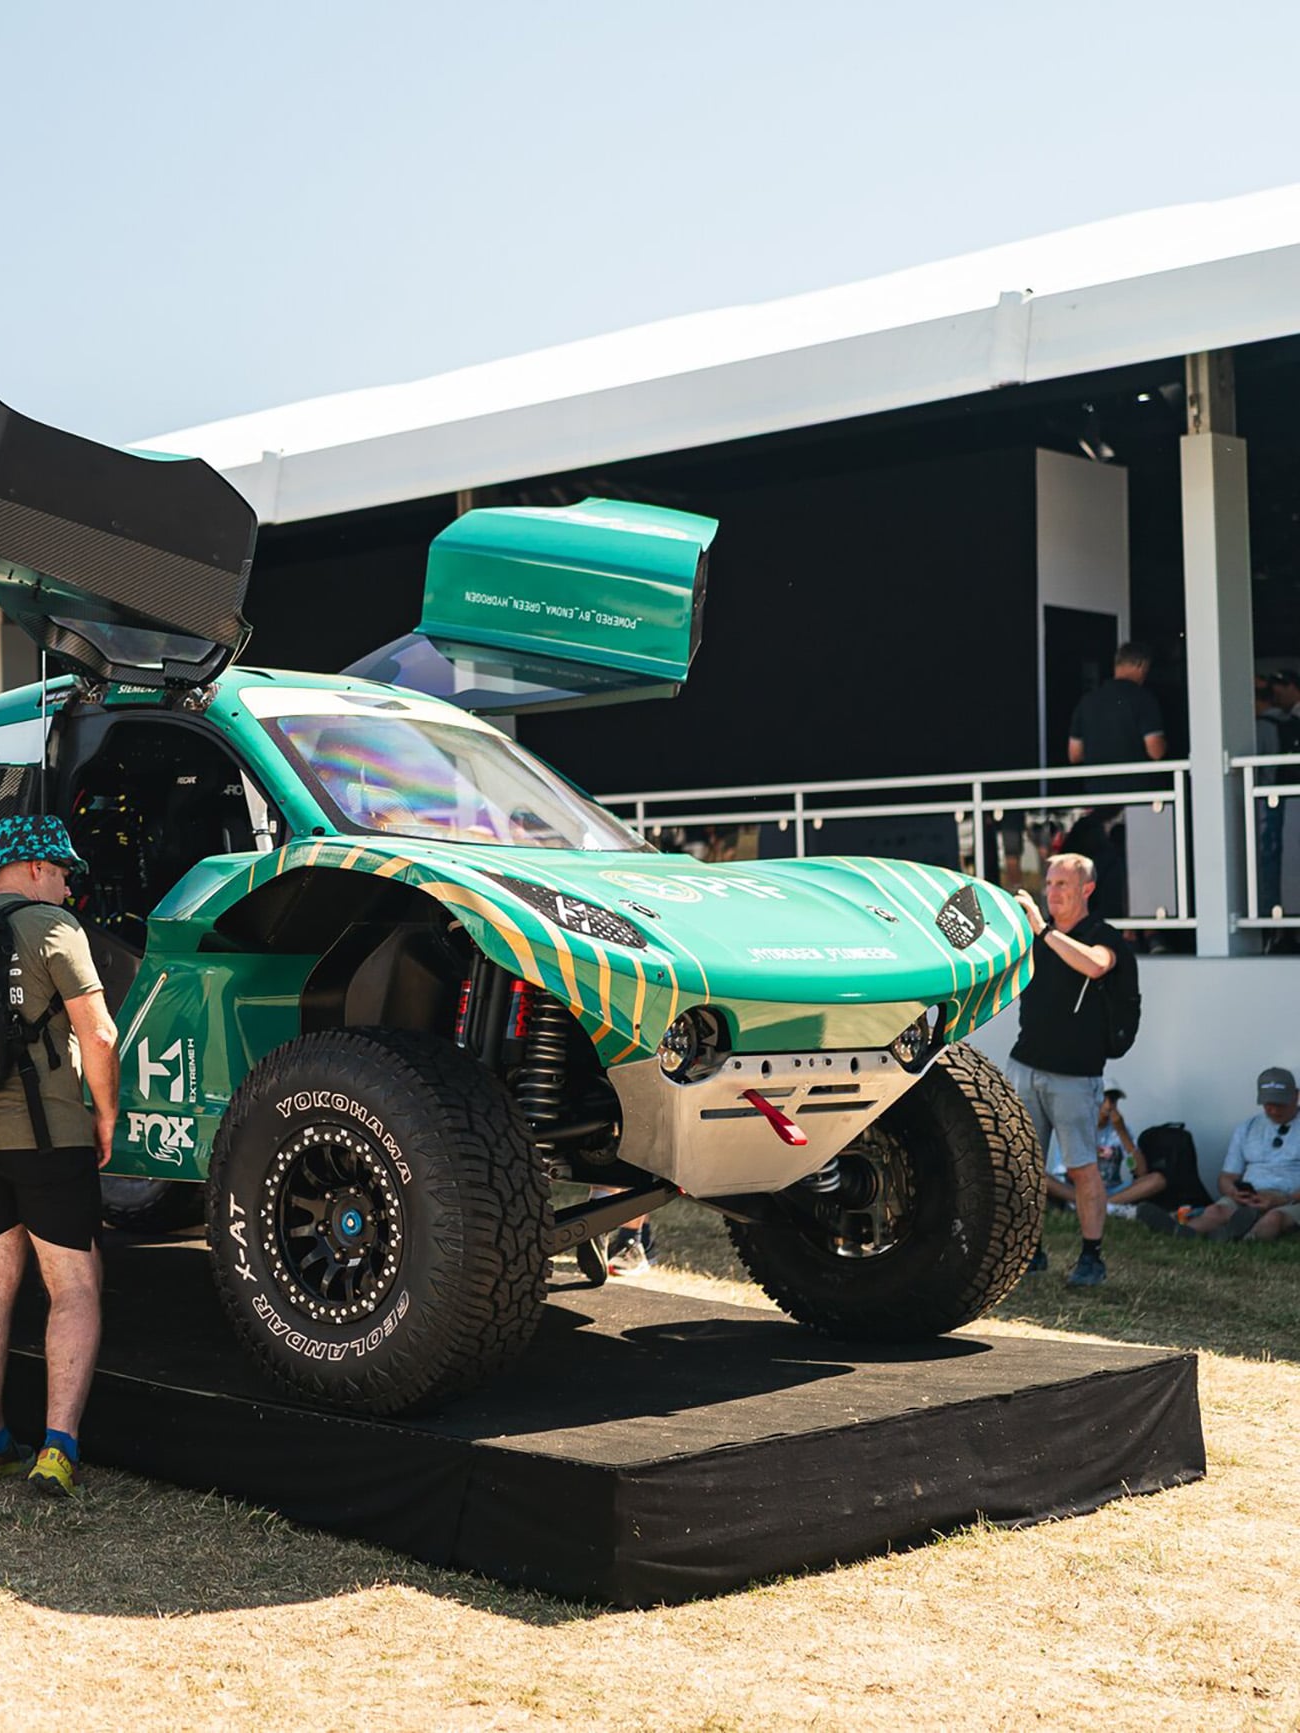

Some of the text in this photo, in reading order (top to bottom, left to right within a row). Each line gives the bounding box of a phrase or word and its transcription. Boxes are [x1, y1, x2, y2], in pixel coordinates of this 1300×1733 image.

[188, 1049, 196, 1103] EXTREME
[127, 1112, 194, 1166] FOX
[276, 1091, 412, 1185] YOKOHAMA
[252, 1289, 411, 1361] GEOLANDAR
